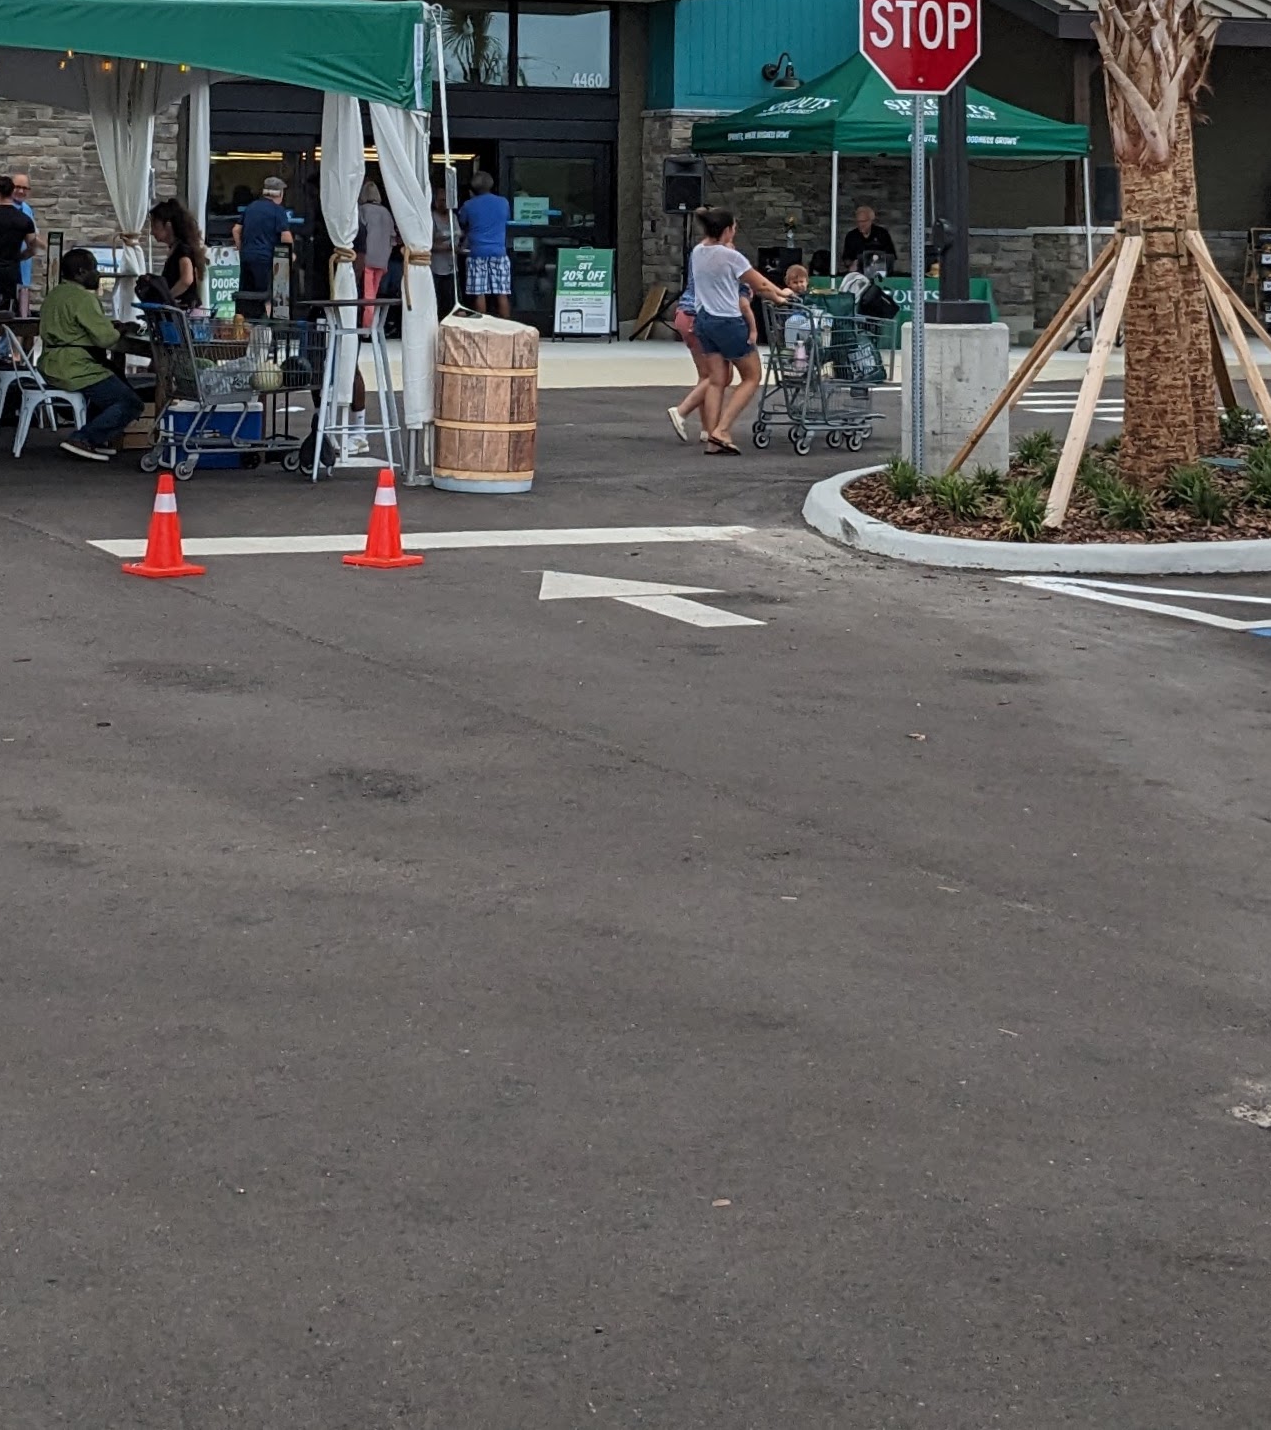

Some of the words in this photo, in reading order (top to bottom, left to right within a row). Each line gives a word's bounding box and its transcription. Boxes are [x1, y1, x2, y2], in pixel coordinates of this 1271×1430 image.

[572, 72, 603, 88] 4460
[578, 262, 593, 270] GET
[561, 270, 585, 281] 20%
[586, 270, 607, 281] OFF
[211, 277, 239, 290] DOORS
[216, 290, 232, 302] OPE
